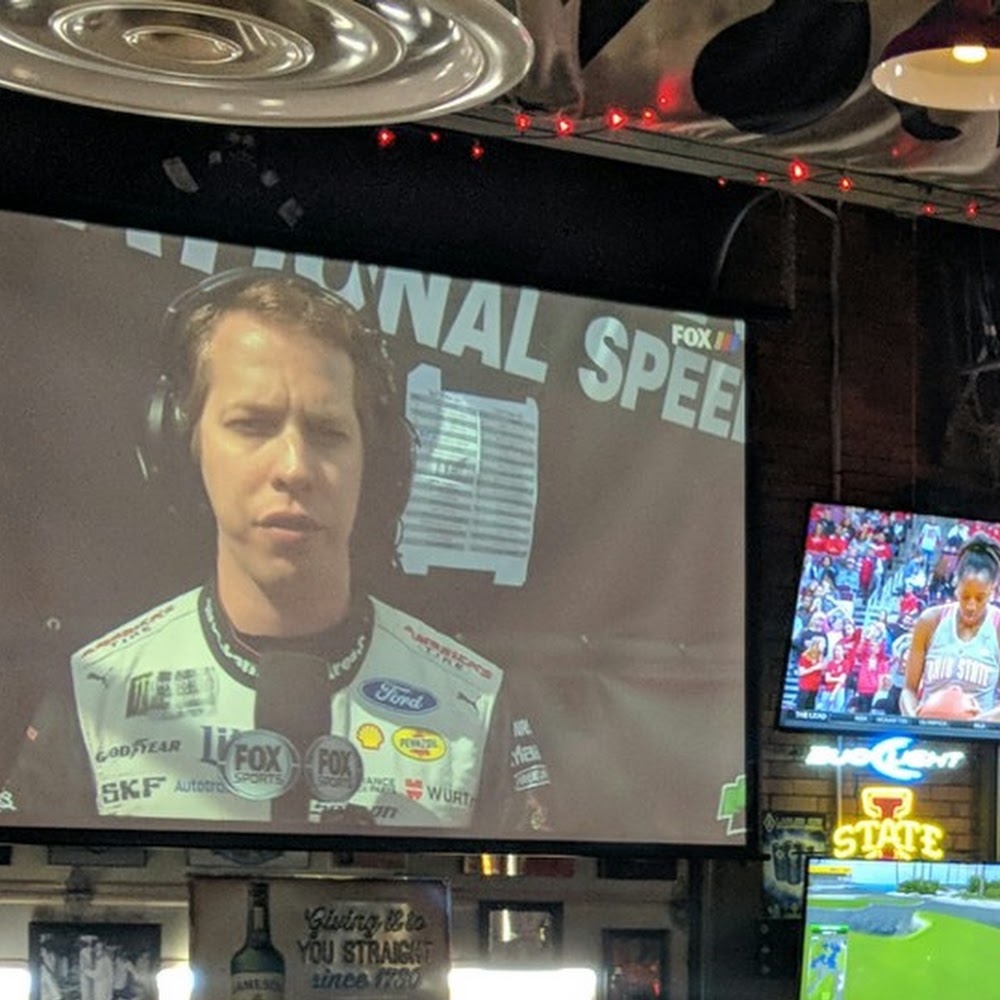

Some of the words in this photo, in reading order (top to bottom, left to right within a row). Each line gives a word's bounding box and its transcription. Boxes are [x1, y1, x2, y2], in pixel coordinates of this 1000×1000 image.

[671, 324, 712, 350] FOX
[578, 317, 745, 443] SPEE
[374, 682, 424, 710] Ford
[235, 744, 283, 773] FOX
[317, 748, 352, 777] FOX
[805, 744, 872, 768] BUD
[102, 776, 167, 804] SKF
[233, 771, 286, 787] SPORTS
[832, 820, 945, 860] STATE
[304, 906, 382, 940] Giving
[297, 938, 334, 965] YOU
[342, 940, 434, 966] STRAIGHT
[312, 969, 369, 990] since
